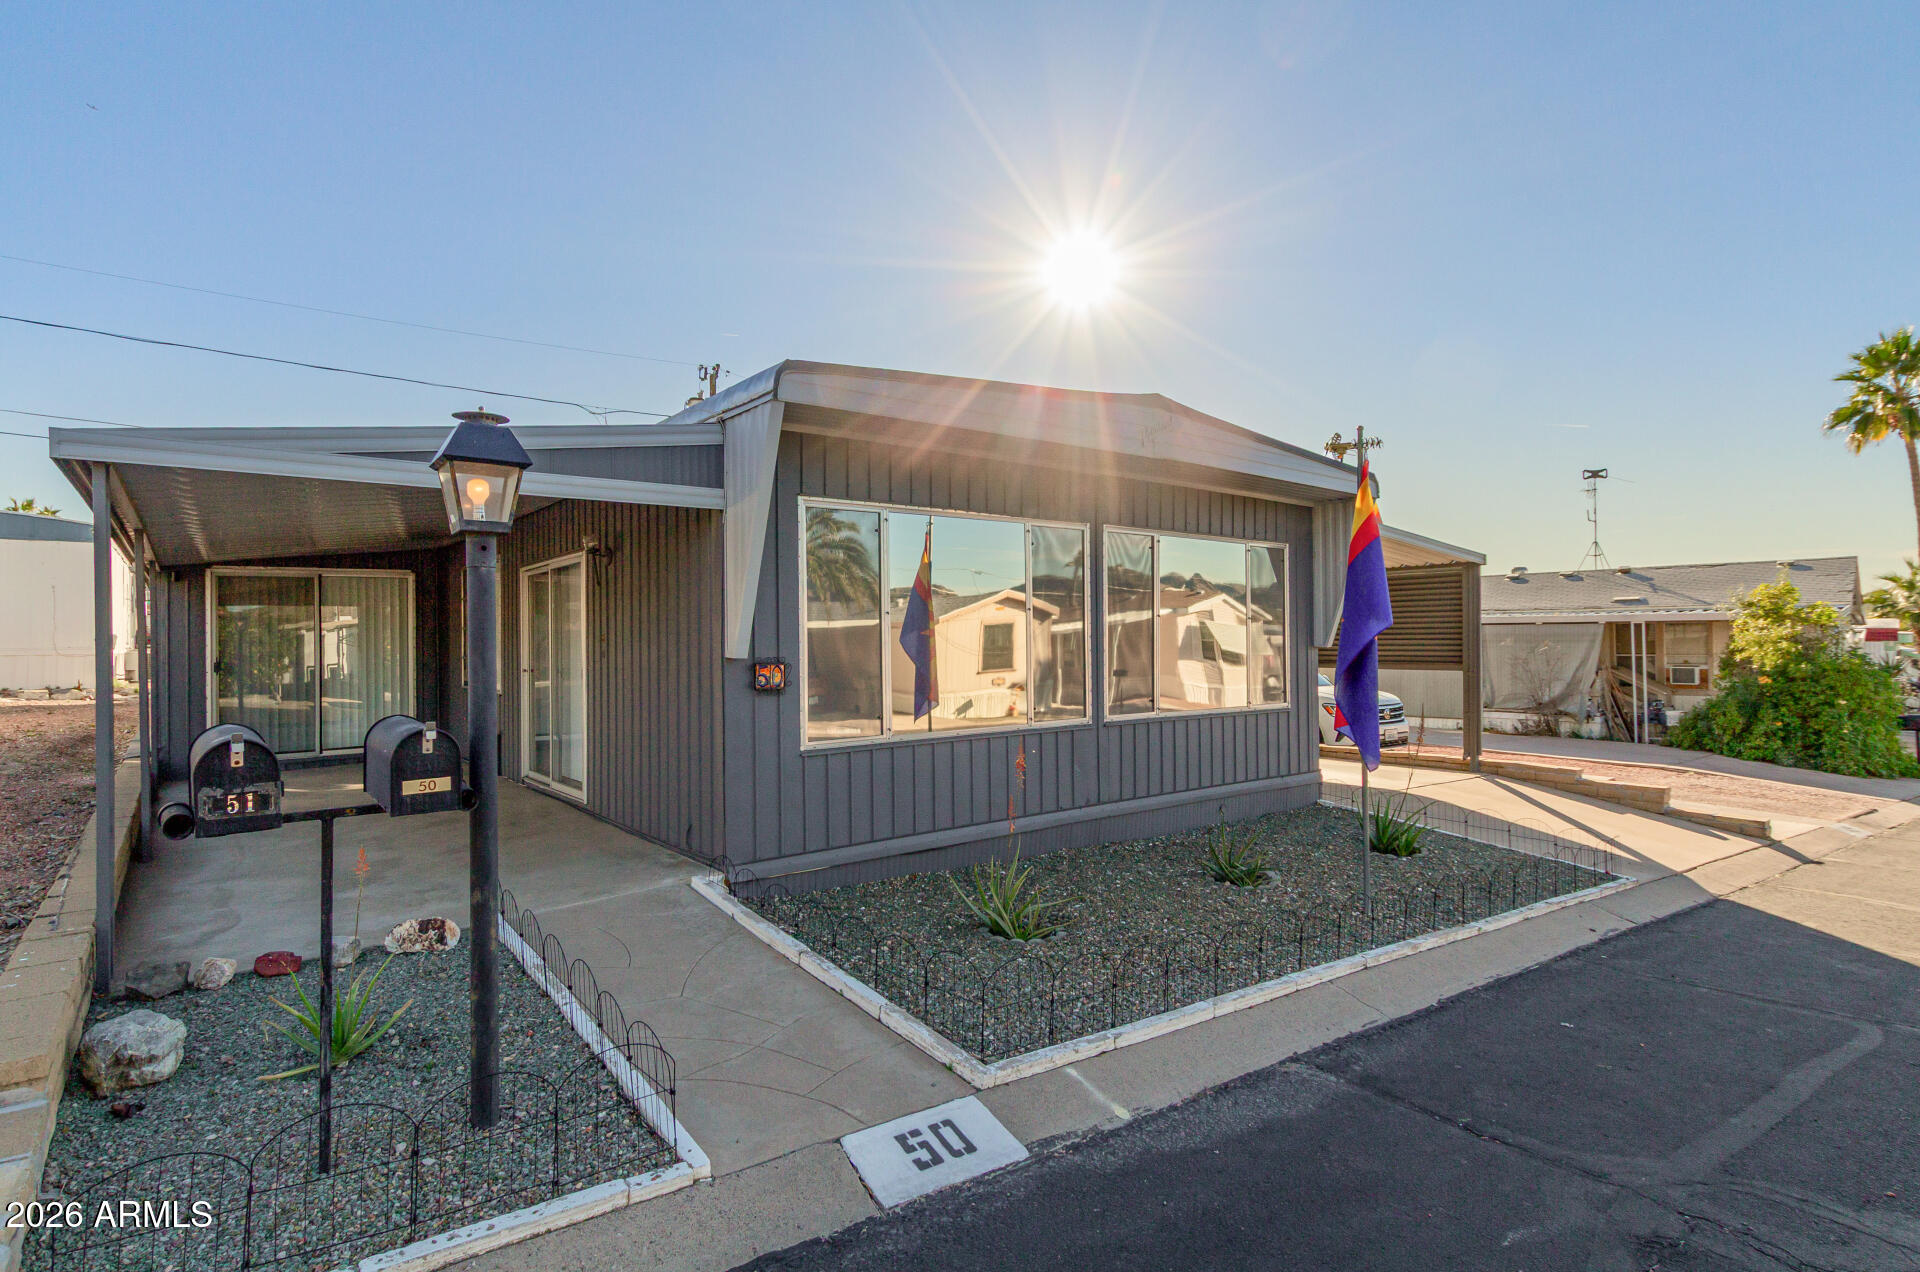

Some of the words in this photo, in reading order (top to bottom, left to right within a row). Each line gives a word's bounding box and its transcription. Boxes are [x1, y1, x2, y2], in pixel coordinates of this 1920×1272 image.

[758, 665, 783, 687] 50
[419, 780, 437, 792] 50
[226, 792, 255, 814] 51
[893, 1119, 978, 1171] 50
